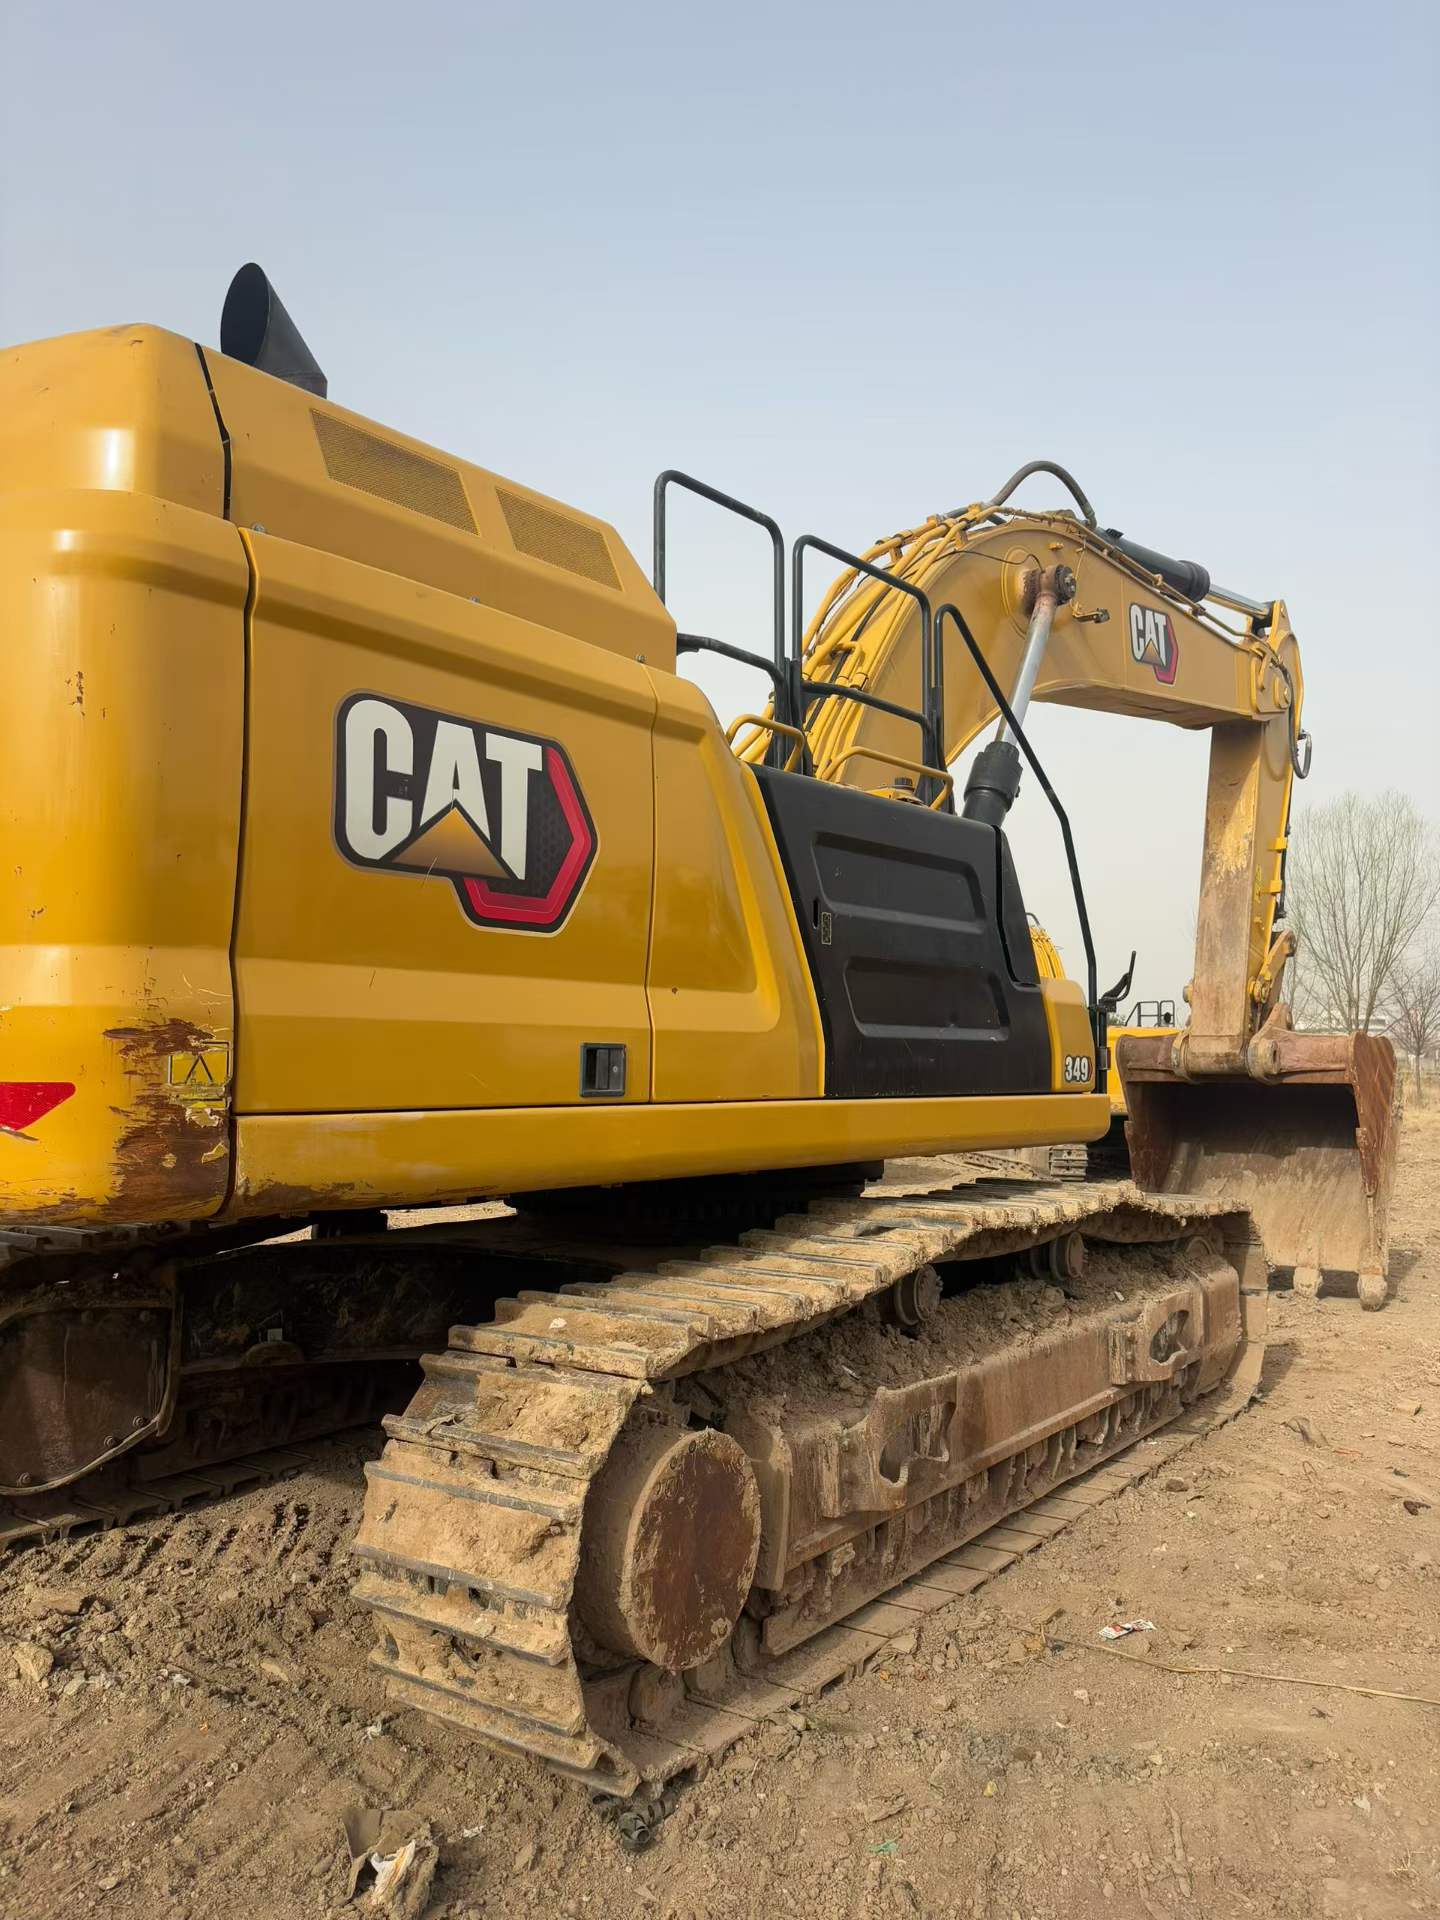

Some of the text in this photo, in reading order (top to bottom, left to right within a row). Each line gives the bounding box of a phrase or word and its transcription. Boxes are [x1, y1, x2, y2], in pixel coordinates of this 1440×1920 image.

[1130, 604, 1167, 667] CAT
[345, 699, 543, 881] CAT
[1065, 1056, 1089, 1081] 349
